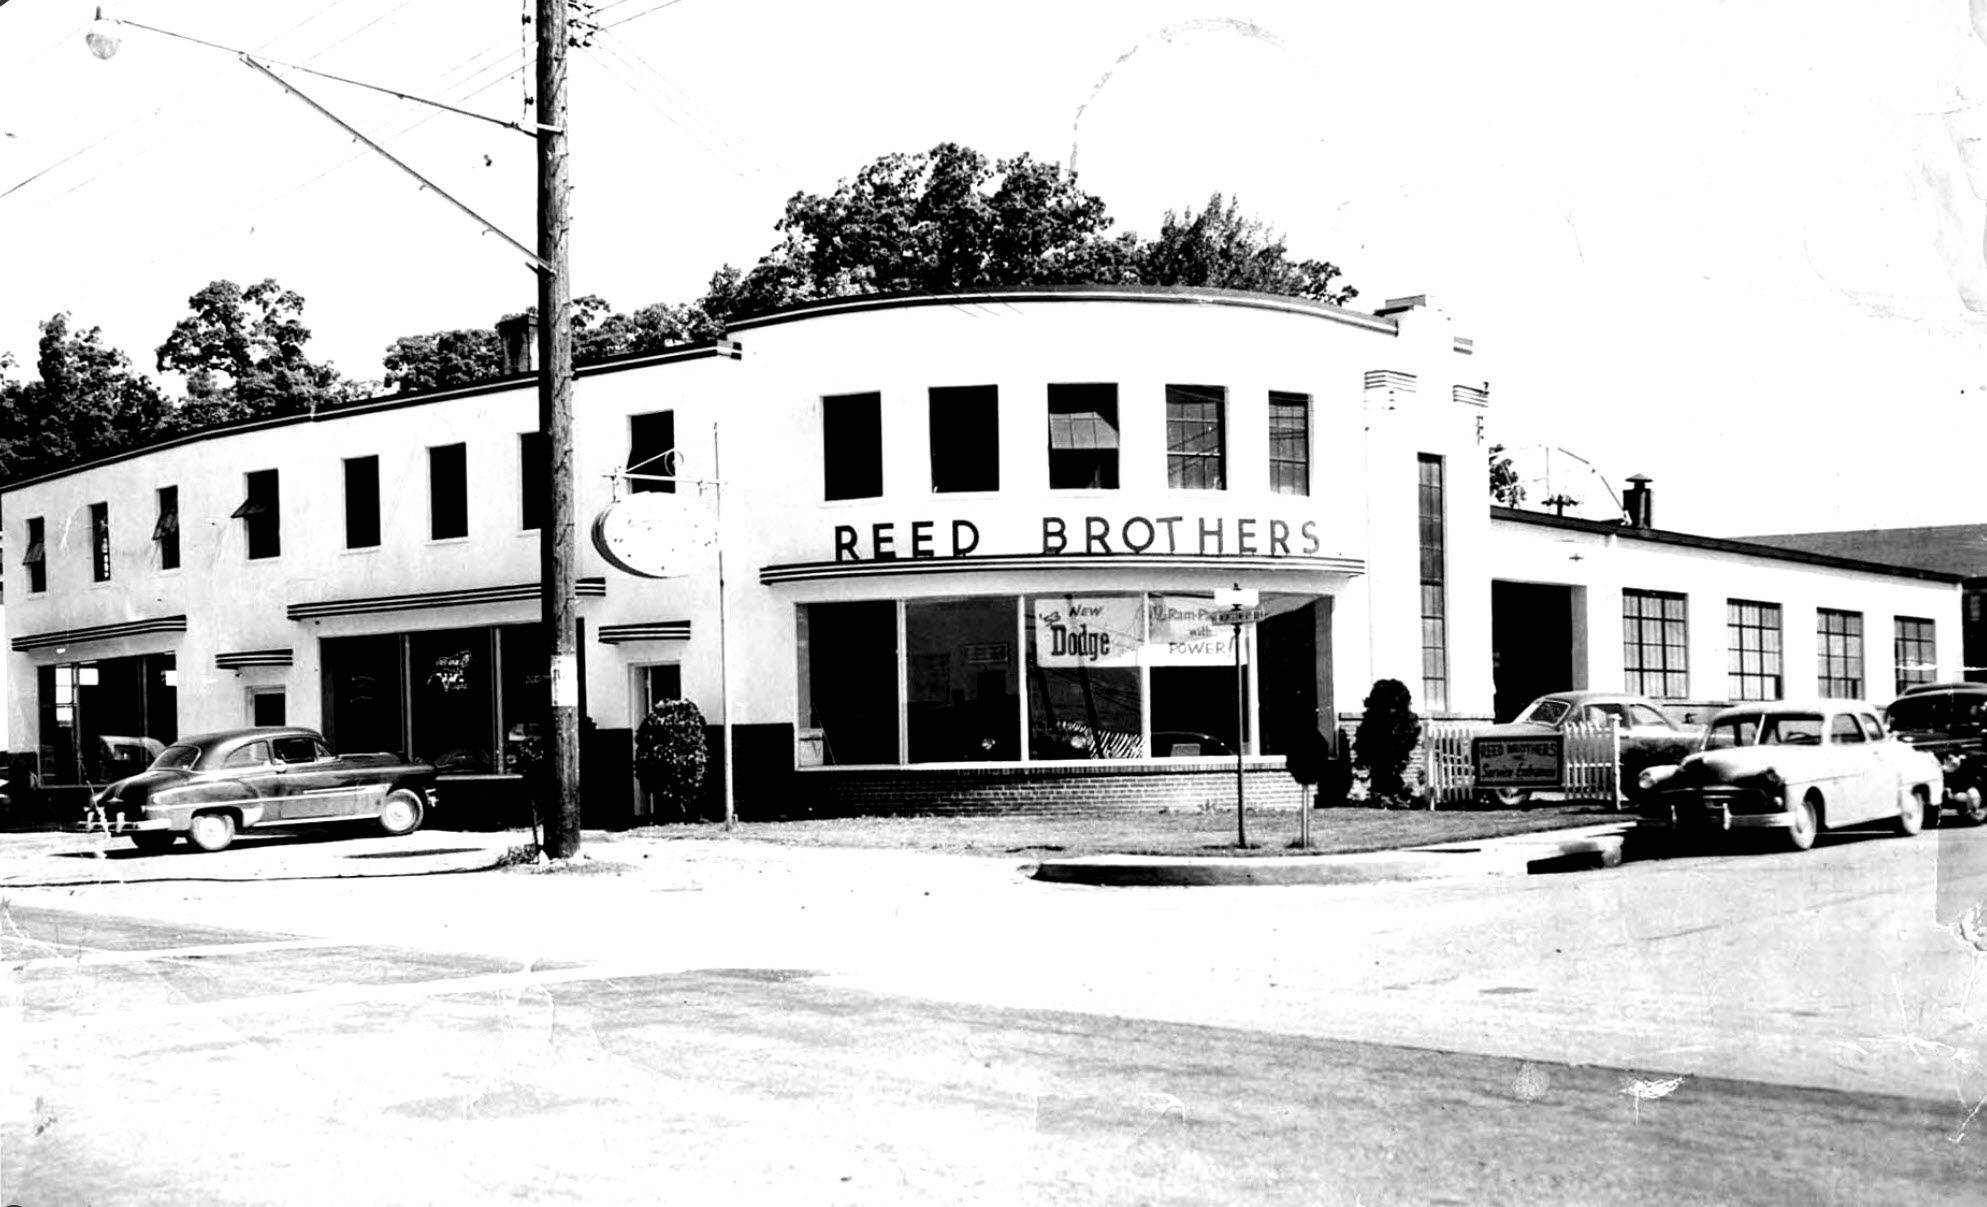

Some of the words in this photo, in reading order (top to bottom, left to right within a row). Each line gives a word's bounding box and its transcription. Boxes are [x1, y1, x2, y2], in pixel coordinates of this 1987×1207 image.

[834, 519, 980, 561] REED
[1041, 515, 1321, 555] BROTHERS
[1069, 604, 1104, 617] NEW
[1050, 622, 1110, 662] Dodge
[1168, 635, 1236, 657] POWER!
